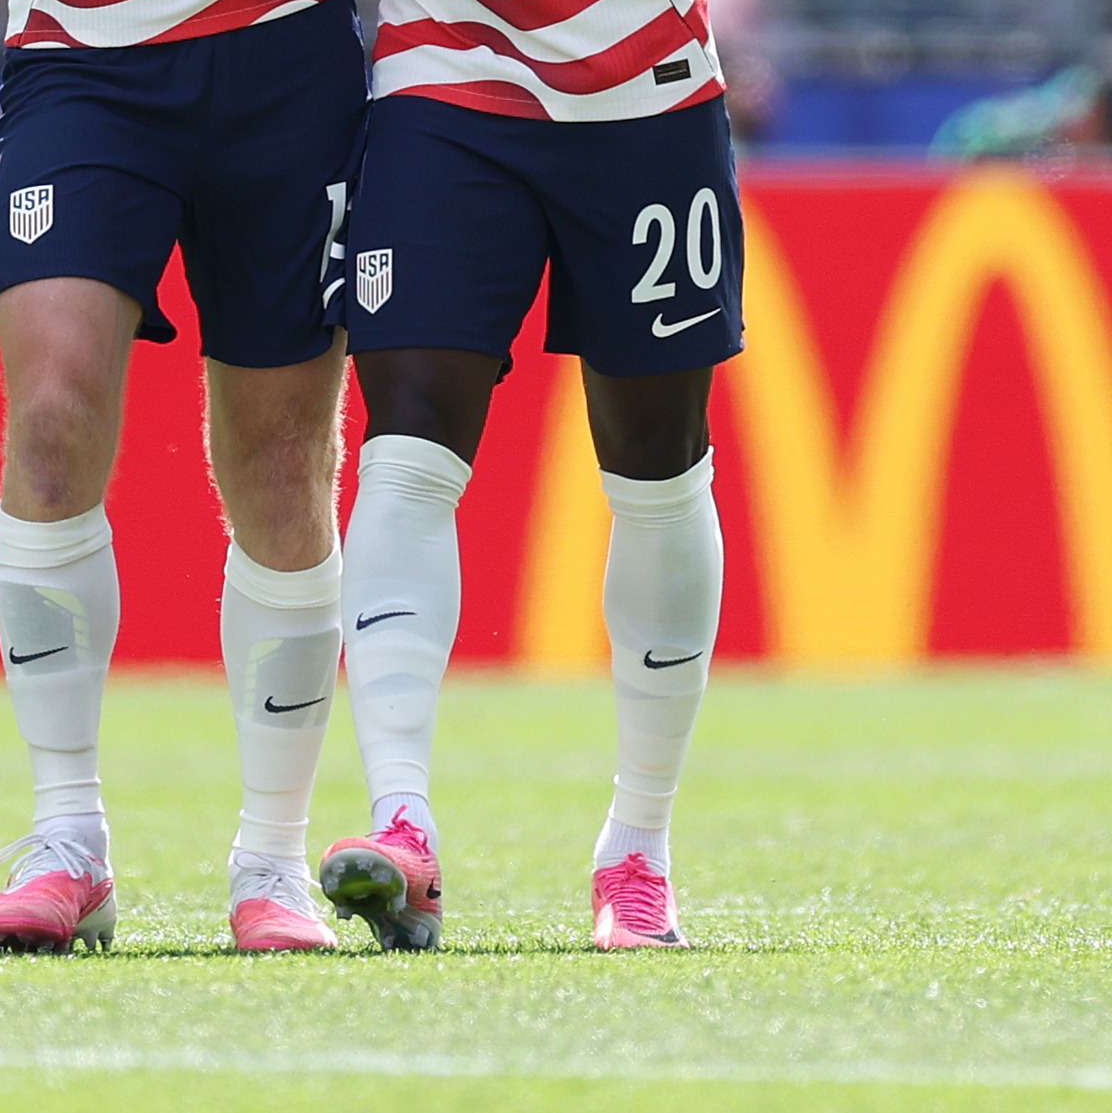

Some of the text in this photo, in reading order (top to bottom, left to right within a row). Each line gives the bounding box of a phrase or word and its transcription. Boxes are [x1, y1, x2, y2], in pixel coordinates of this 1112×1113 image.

[13, 188, 49, 211] USA
[631, 187, 722, 304] 20
[359, 253, 389, 277] USA
